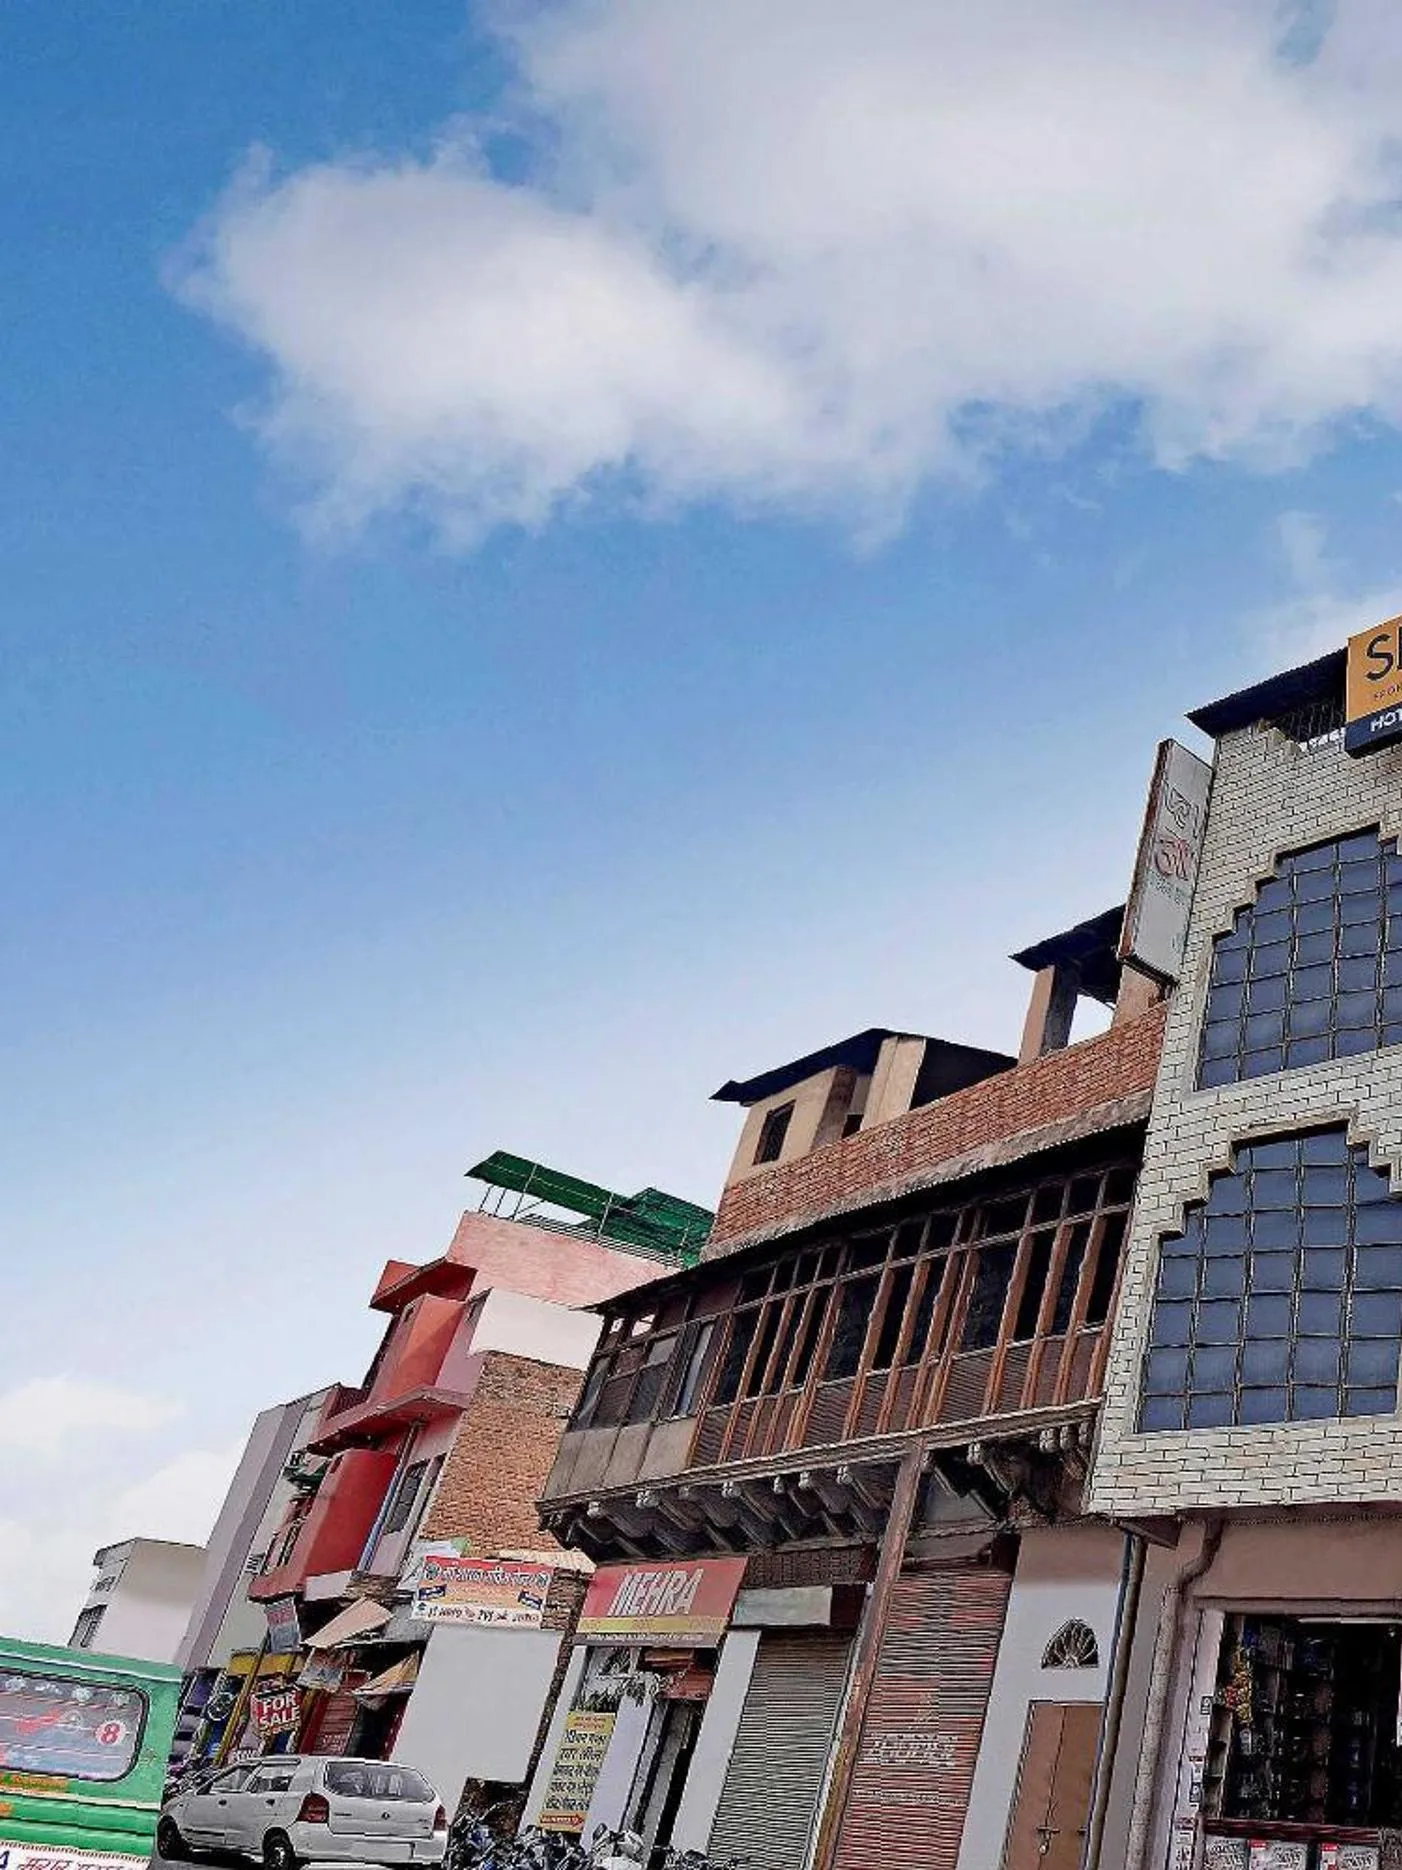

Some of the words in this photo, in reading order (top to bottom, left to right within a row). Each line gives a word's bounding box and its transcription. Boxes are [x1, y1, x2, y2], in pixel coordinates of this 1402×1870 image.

[607, 1568, 704, 1617] MEHRA
[262, 1693, 297, 1714] FOR
[259, 1705, 301, 1730] SALE
[100, 1722, 121, 1745] 8
